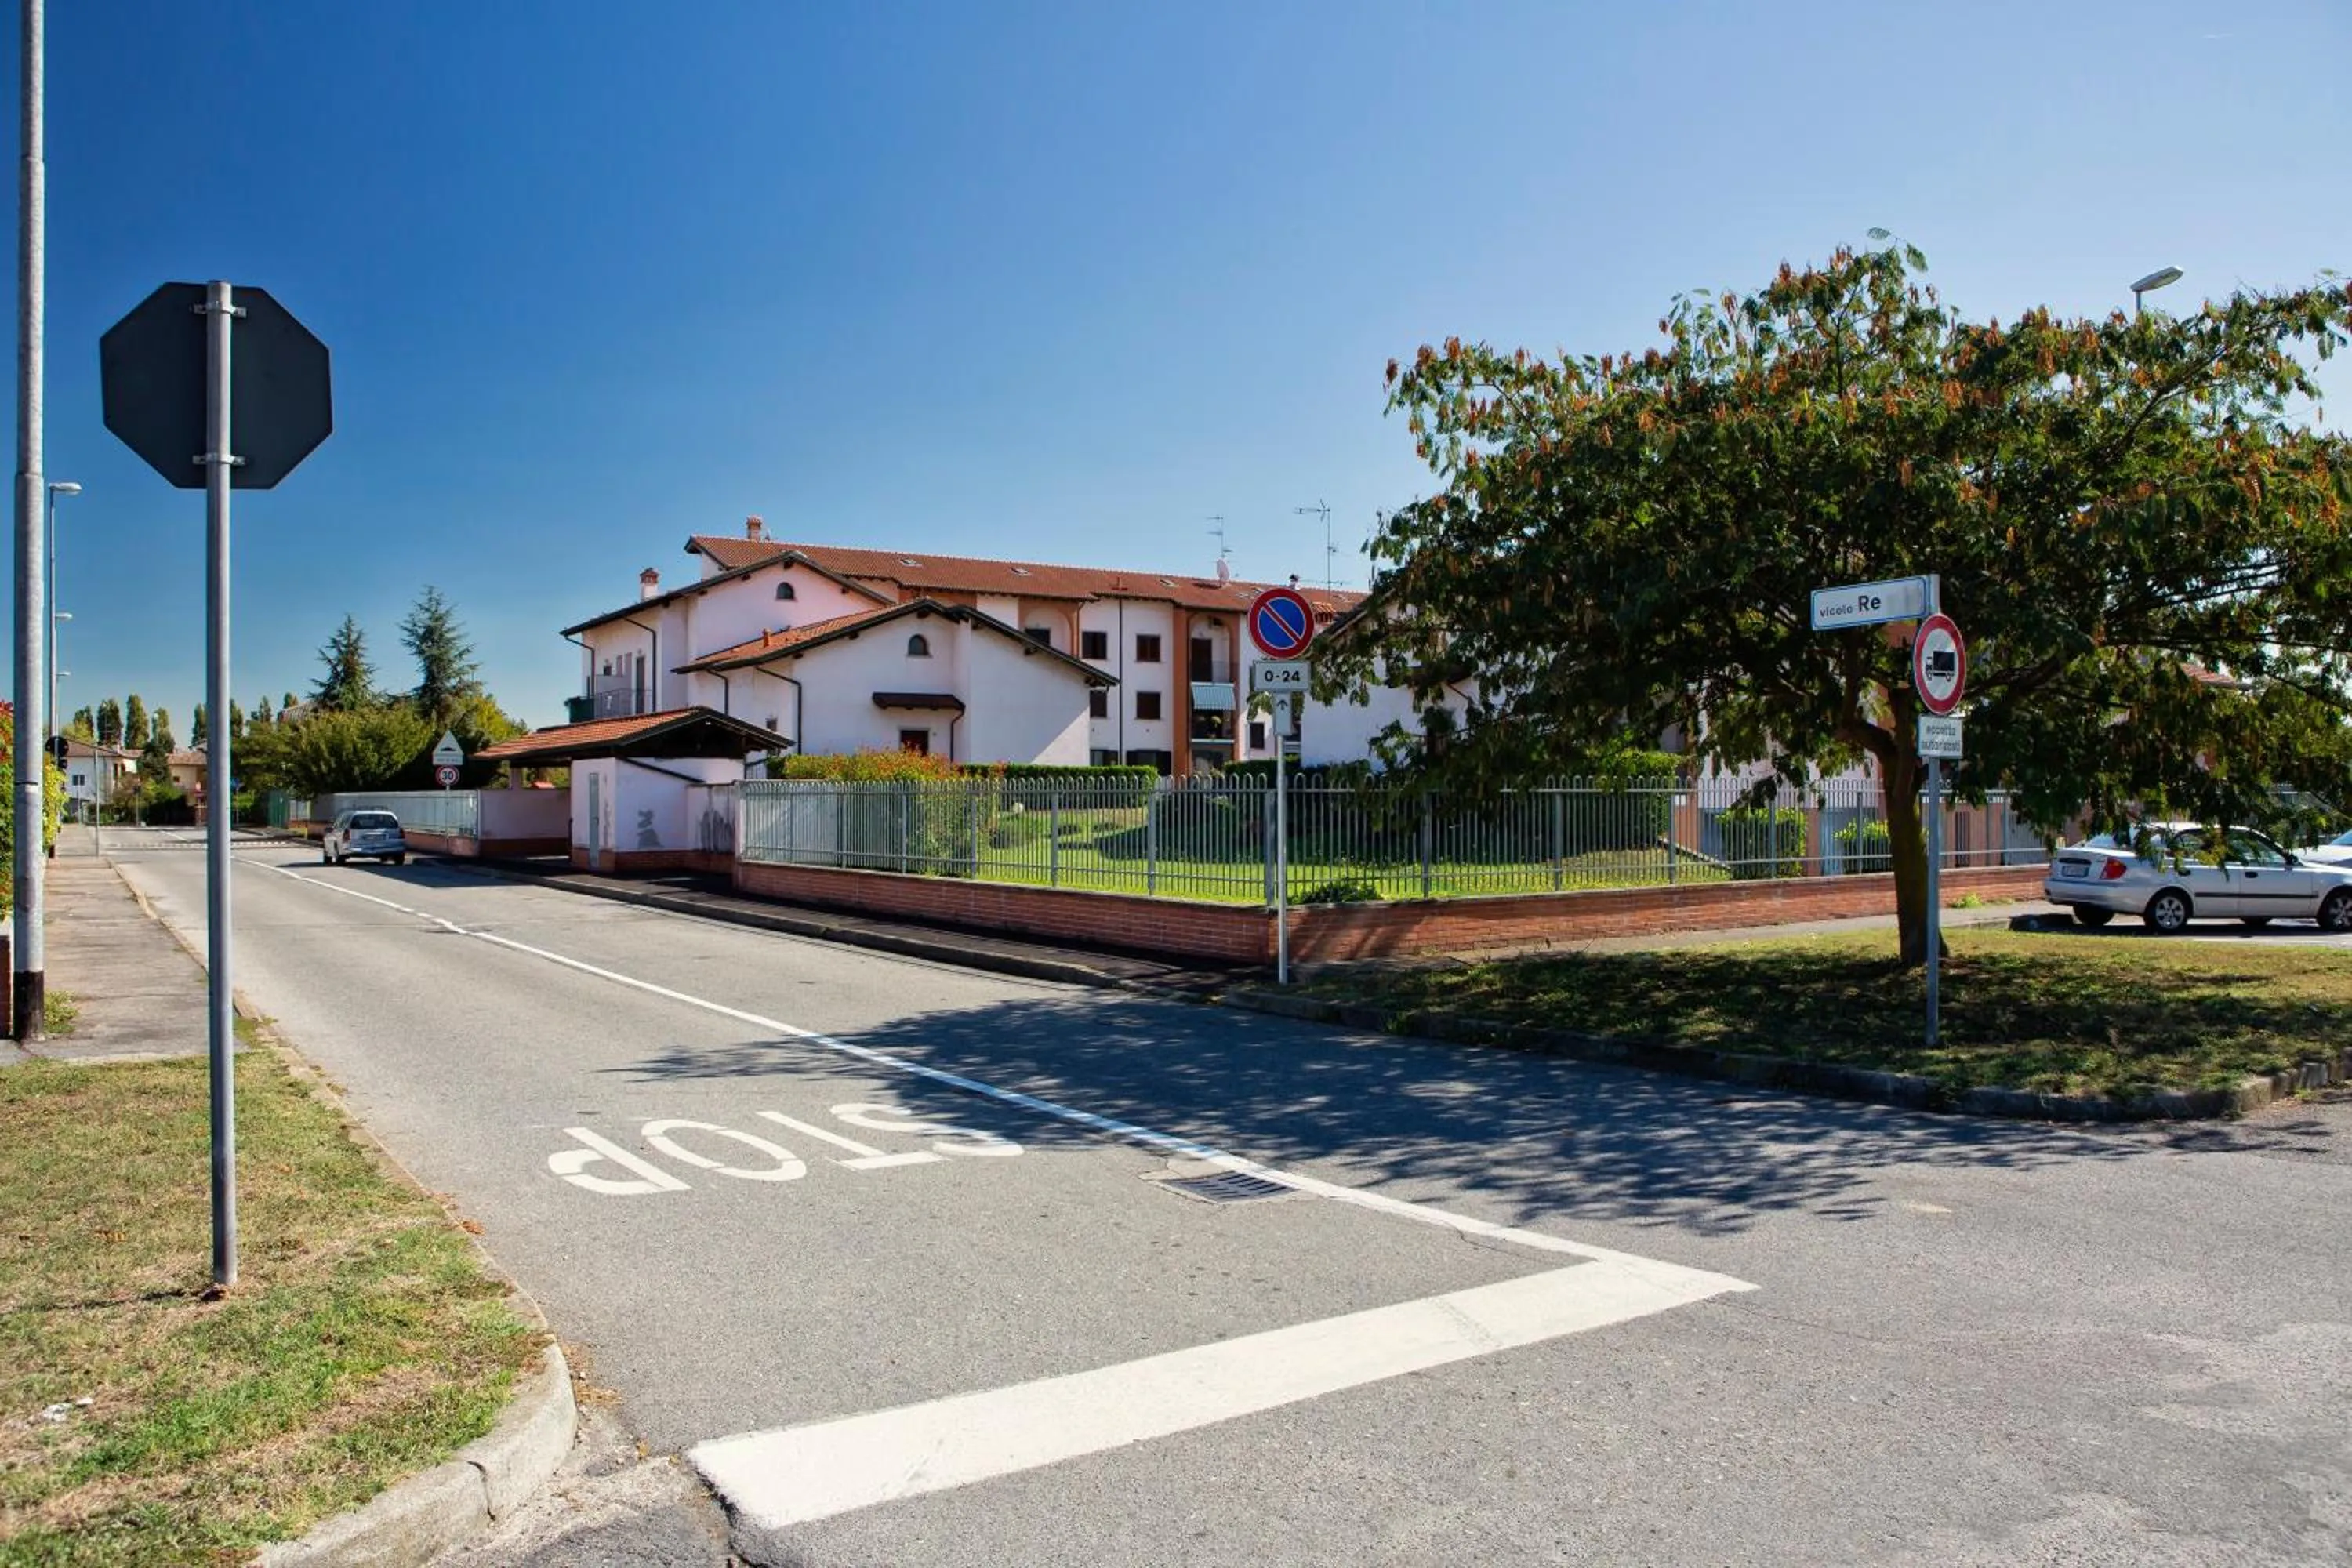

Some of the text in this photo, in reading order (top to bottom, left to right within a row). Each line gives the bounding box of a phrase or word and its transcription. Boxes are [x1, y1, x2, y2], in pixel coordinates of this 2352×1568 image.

[1820, 595, 1882, 617] vicolo Re
[1264, 670, 1301, 682] 0-24
[441, 771, 454, 781] 30
[548, 1102, 1024, 1195] STOP
